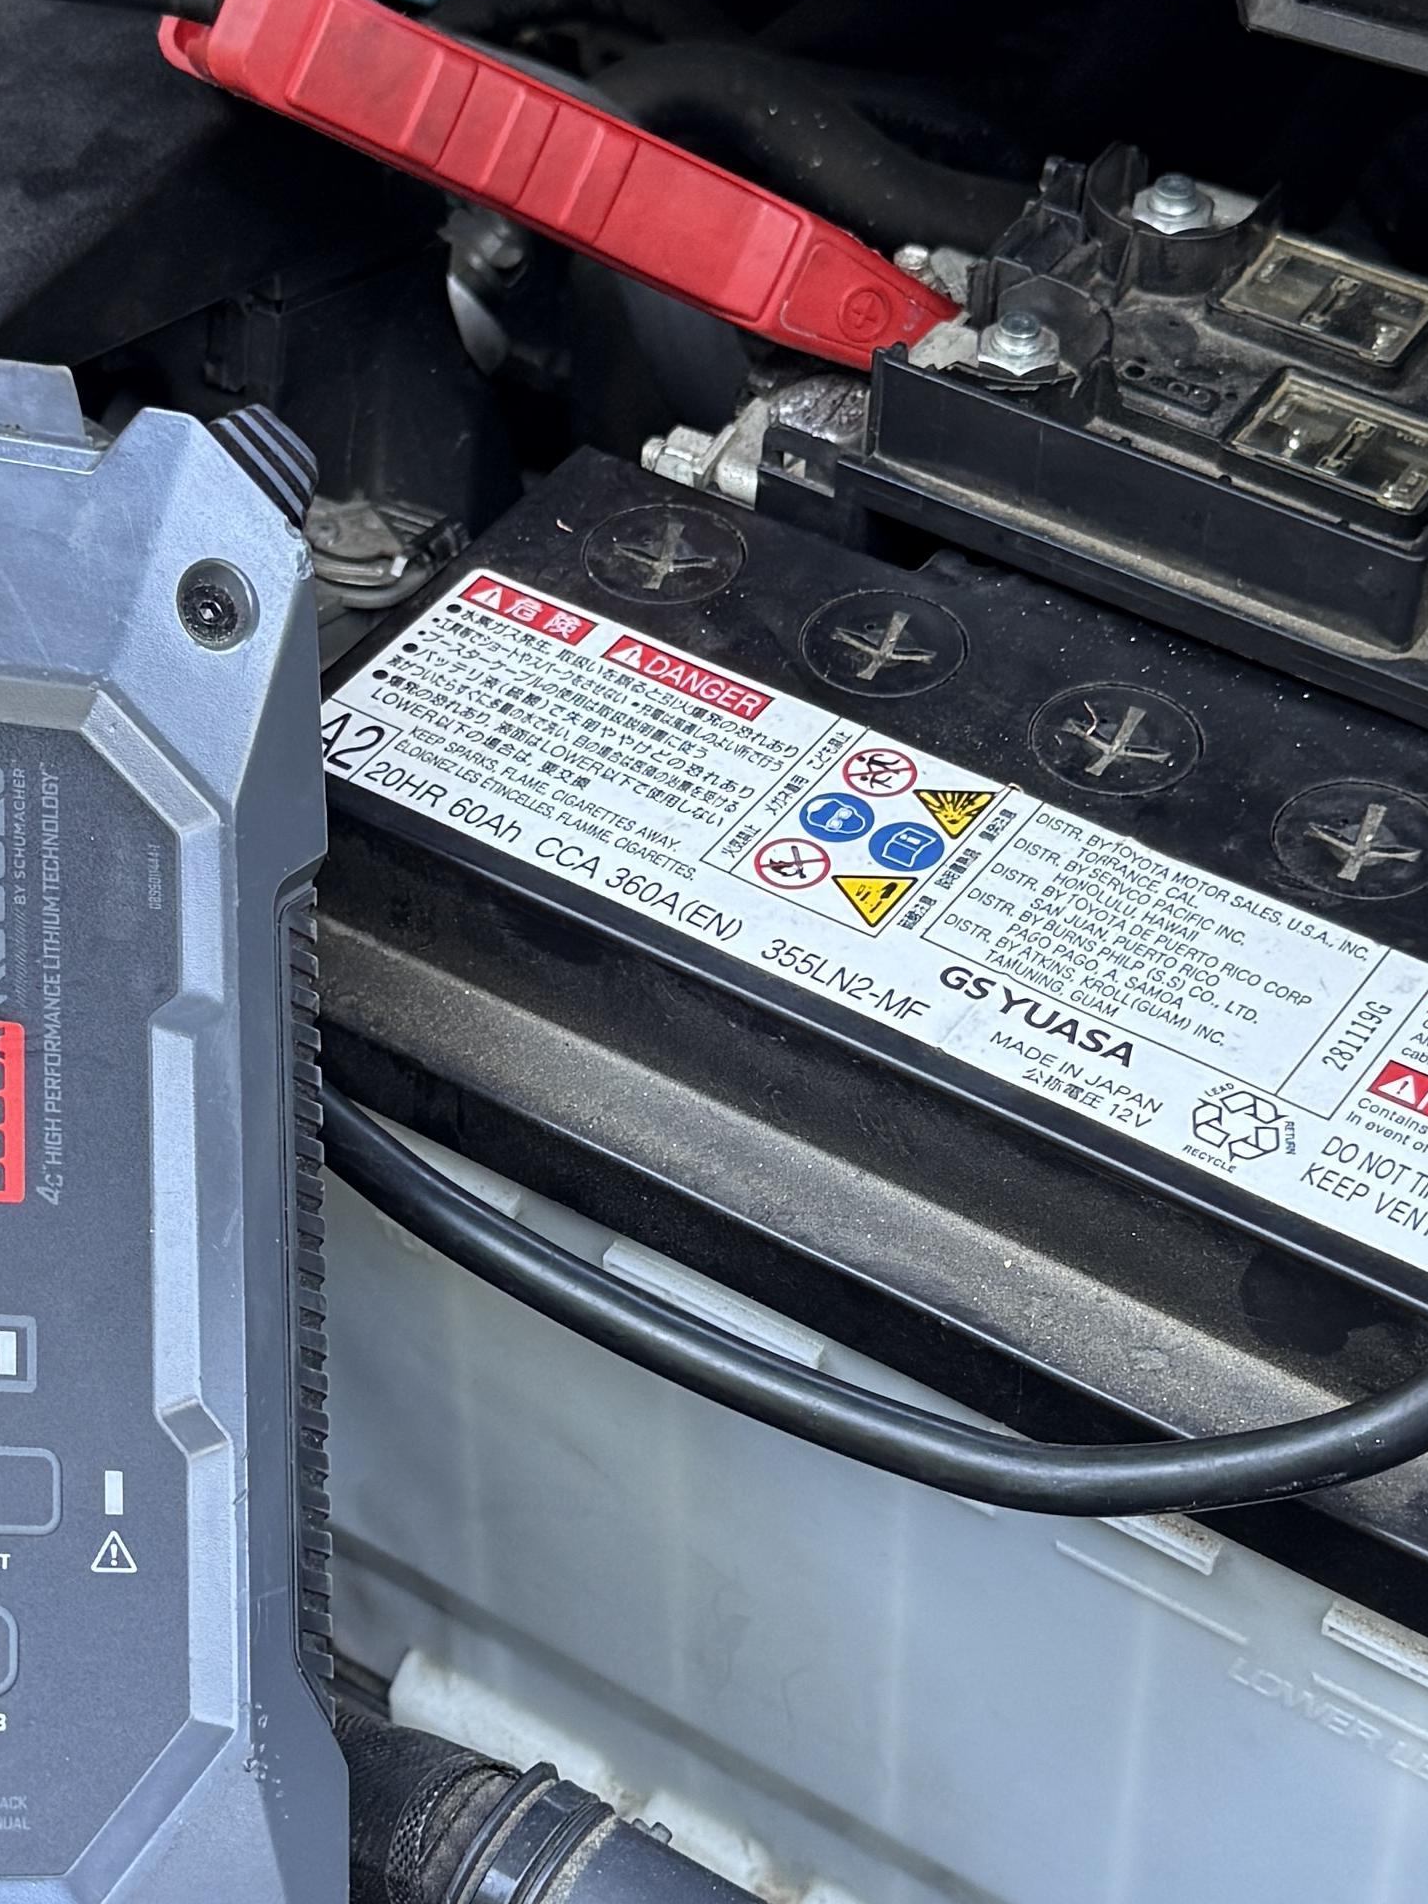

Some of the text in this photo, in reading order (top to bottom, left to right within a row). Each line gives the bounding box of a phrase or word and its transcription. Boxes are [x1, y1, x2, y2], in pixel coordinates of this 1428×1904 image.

[504, 597, 582, 639] 危険
[643, 655, 762, 716] DANGER
[407, 724, 447, 747] KEEP
[550, 789, 637, 832] CIGARETTES
[633, 825, 682, 853] AWAY.
[453, 765, 483, 784] LES
[613, 836, 697, 882] CIGARETTES.
[13, 886, 27, 905] BY
[363, 761, 449, 809] 20HR
[447, 797, 523, 844] 60Ah
[535, 836, 601, 880] CCA
[604, 867, 743, 942] 360A(EN)
[760, 938, 932, 1020] 355LN2-MF
[1012, 837, 1246, 947] DISTR. BY SERVCO PACIFIC INC.
[1035, 812, 1084, 843] DISTR.
[1085, 834, 1114, 851] BY
[1110, 841, 1170, 880] TOYOTA
[1169, 871, 1231, 903] MOTOR
[1229, 895, 1283, 927] SALES,
[1337, 938, 1370, 962] INC.
[1051, 871, 1200, 943] HONOLULU, HAWAII
[1164, 886, 1199, 910] CAL.
[42, 896, 62, 969] LITHIUM
[966, 887, 1016, 918] DISTR.
[1017, 909, 1045, 927] BY
[1041, 918, 1098, 953] BURNS
[1096, 946, 1146, 971] PHILP
[1224, 999, 1258, 1025] LTD.
[989, 862, 1039, 893] DISTR.
[1040, 884, 1068, 902] BY
[1066, 893, 1127, 932] TOYOTA
[1128, 923, 1156, 942] DE
[1152, 933, 1220, 969] PUERTO
[1219, 961, 1262, 987] RICO
[1263, 980, 1313, 1006] CORP
[1005, 922, 1052, 950] PAGO
[1051, 943, 1099, 976] PAGO,
[1123, 975, 1184, 1011] SAMOA
[1029, 897, 1221, 987] SAN JUAN, PUERTO RICO
[943, 913, 1225, 1047] DISTR. BY ATKINS, KROLL(GUAM) INC.
[984, 948, 1121, 1018] TAMUNING, GUAM
[43, 973, 63, 1111] PERFORMANCE
[939, 965, 1134, 1069] GS YUASA
[989, 1030, 1164, 1114] MADE IN JAPAN
[1204, 1082, 1235, 1097] LEAD
[43, 1115, 63, 1166] HIGH
[1108, 1103, 1153, 1128] 12V
[1284, 1121, 1297, 1156] RETURN
[1344, 1110, 1363, 1126] In
[1364, 1121, 1411, 1146] event
[1181, 1144, 1237, 1174] RECYCLE
[1299, 1161, 1371, 1202] KEEP
[1320, 1135, 1360, 1164] DO
[1356, 1151, 1413, 1186] NOT
[1227, 1656, 1384, 1751] LOWER
